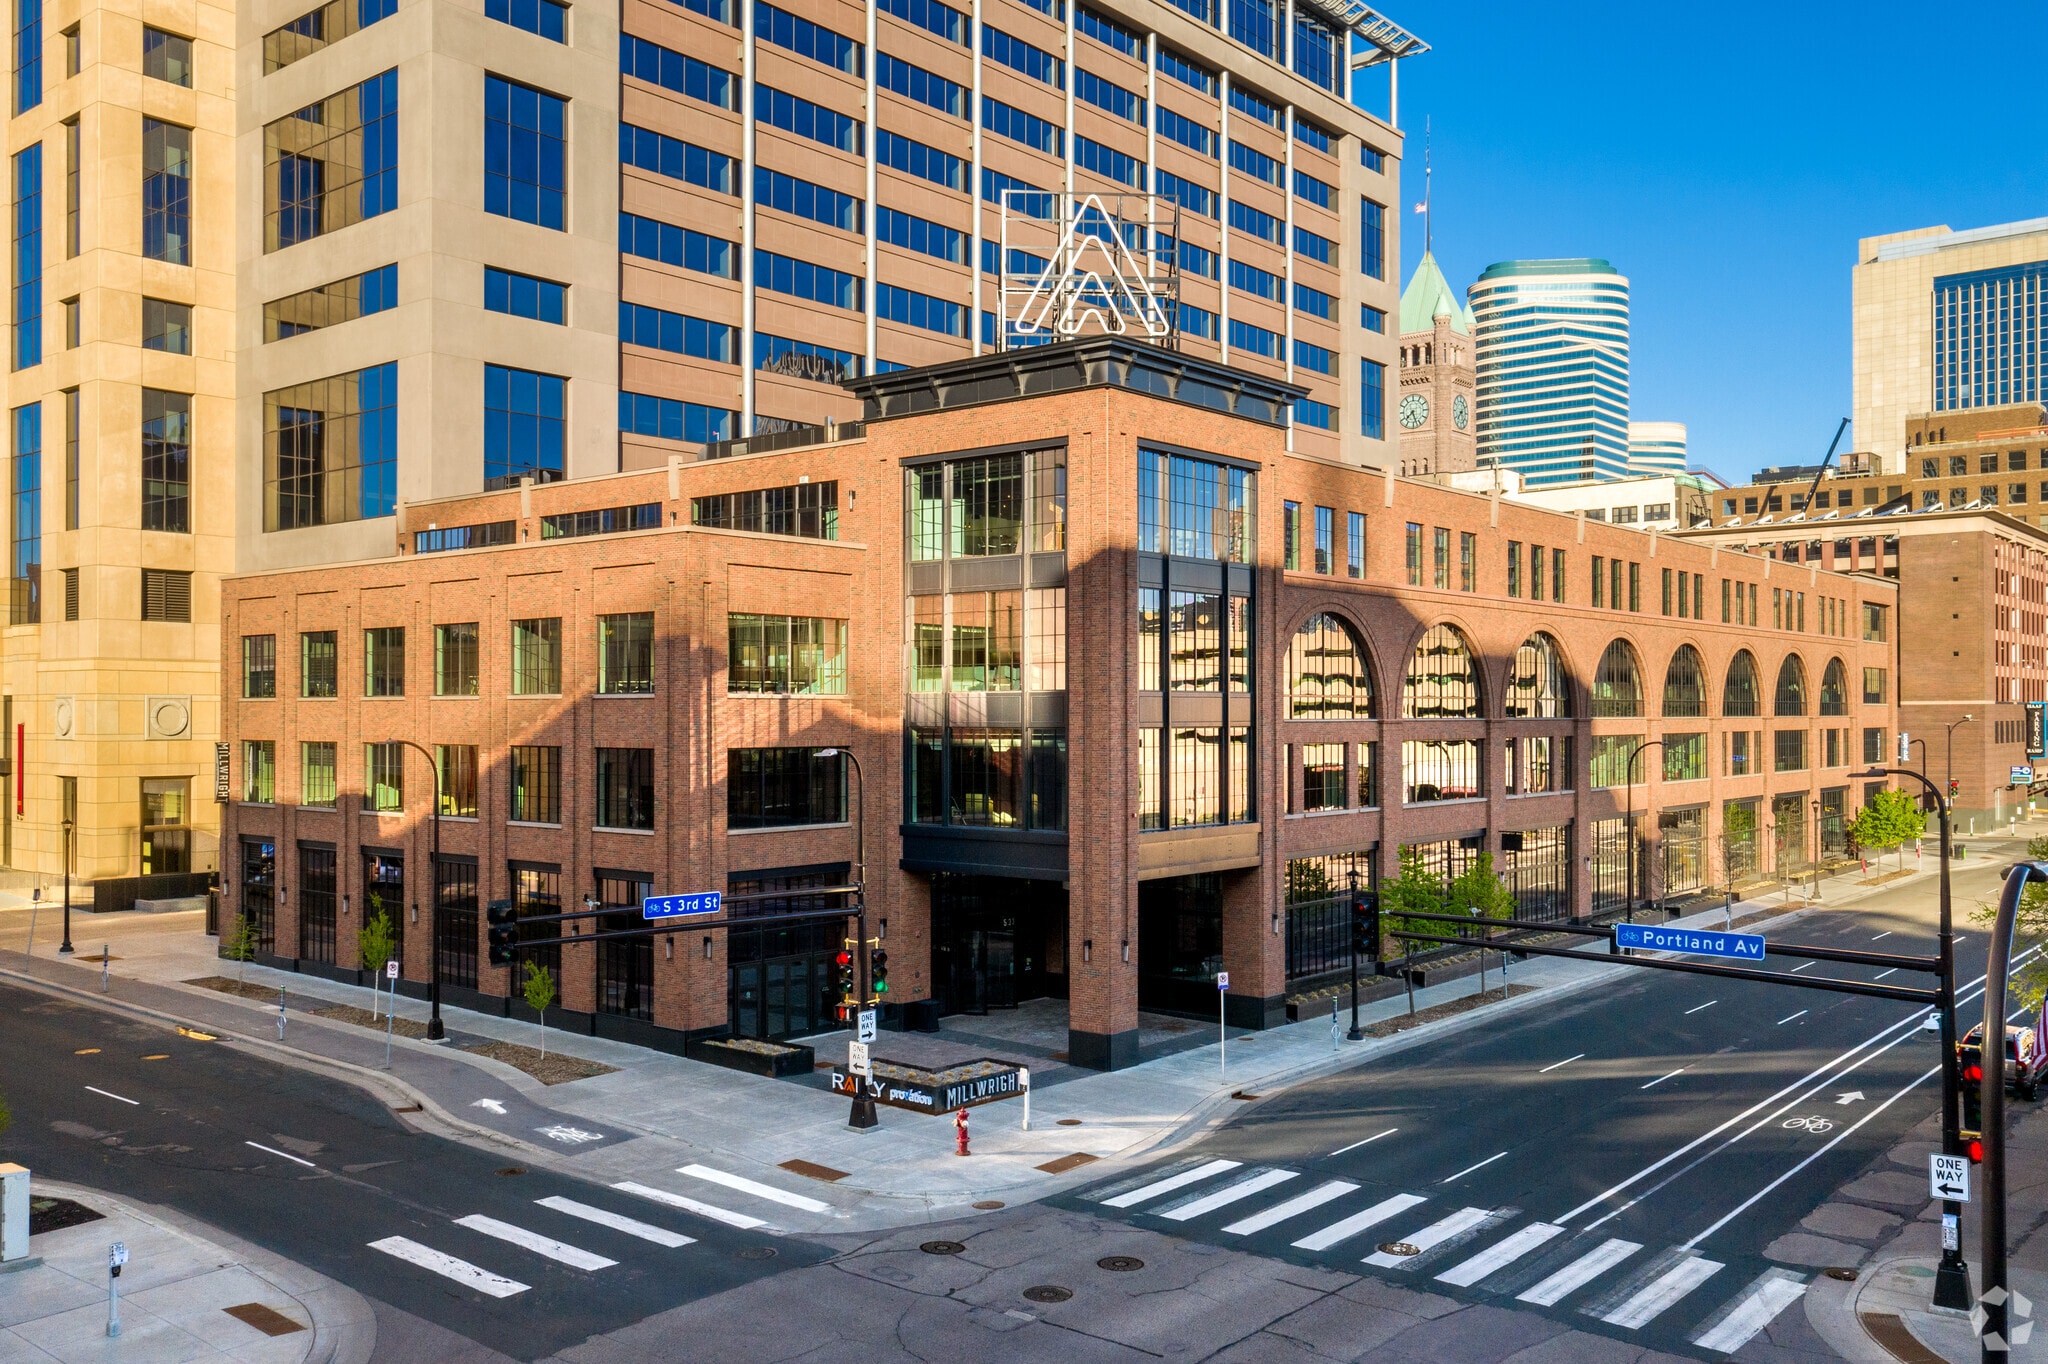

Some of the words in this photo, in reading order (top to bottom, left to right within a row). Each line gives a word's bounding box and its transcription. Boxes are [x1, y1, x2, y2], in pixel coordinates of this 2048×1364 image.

[2033, 711, 2041, 747] PARKING
[217, 742, 229, 804] MILLWRIGHT
[663, 900, 672, 913] S
[677, 898, 699, 912] 3rd
[704, 896, 718, 909] St
[1643, 931, 1725, 951] Portland
[1734, 939, 1759, 954] Av
[861, 1012, 873, 1023] ONE
[860, 1021, 874, 1031] WAY
[852, 1044, 865, 1054] ONE
[852, 1052, 865, 1061] WAY
[1936, 1157, 1962, 1171] ONE
[1935, 1169, 1963, 1182] WAY
